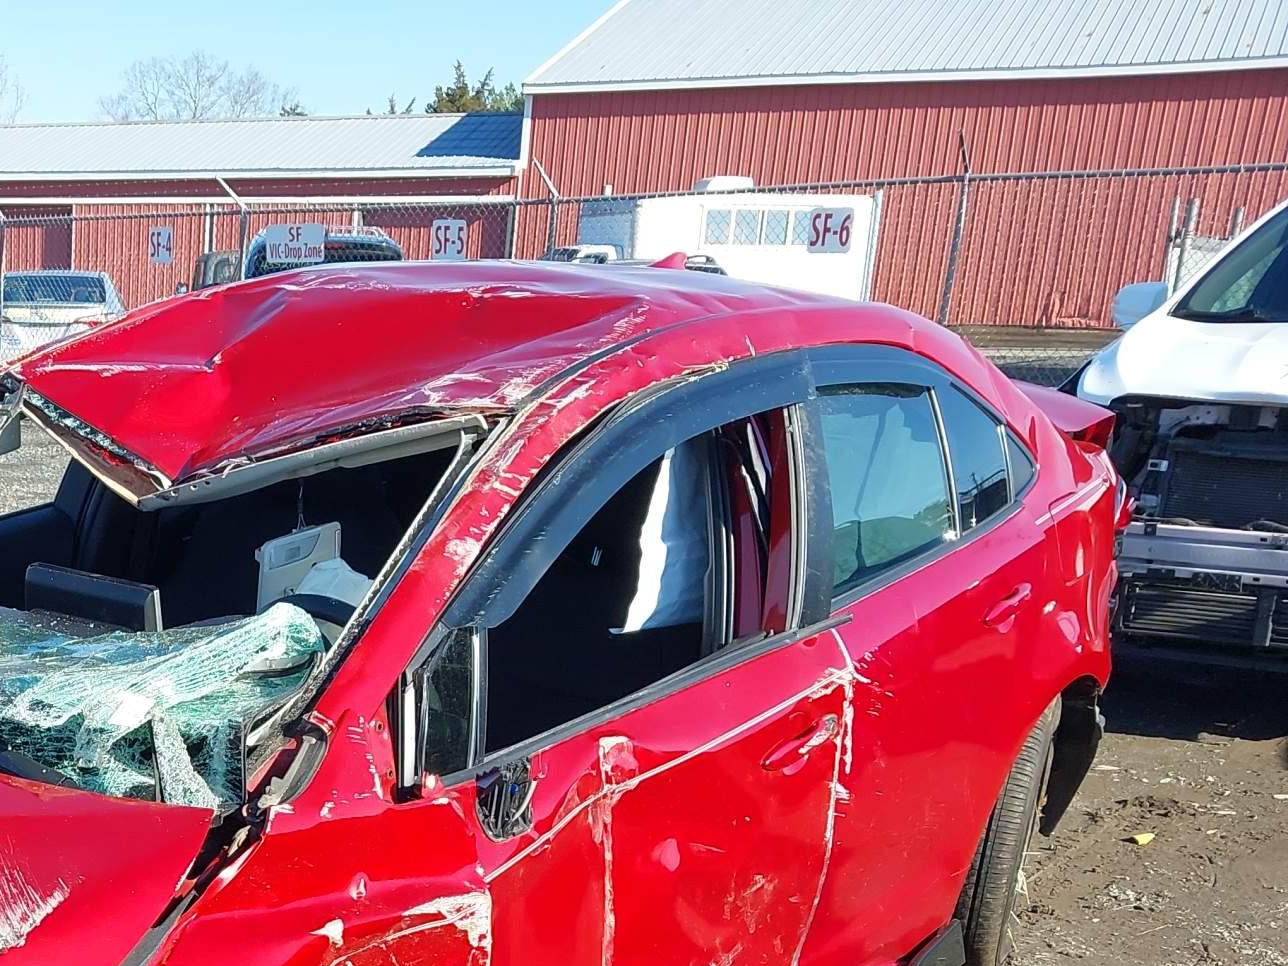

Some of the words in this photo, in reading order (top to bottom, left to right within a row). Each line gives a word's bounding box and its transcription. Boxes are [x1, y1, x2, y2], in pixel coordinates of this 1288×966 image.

[288, 226, 302, 242] SF
[435, 225, 464, 254] SF-5
[809, 213, 851, 247] SF-6
[150, 231, 172, 258] SF-4
[269, 243, 303, 261] VIC-Drop
[303, 242, 323, 259] Zone
